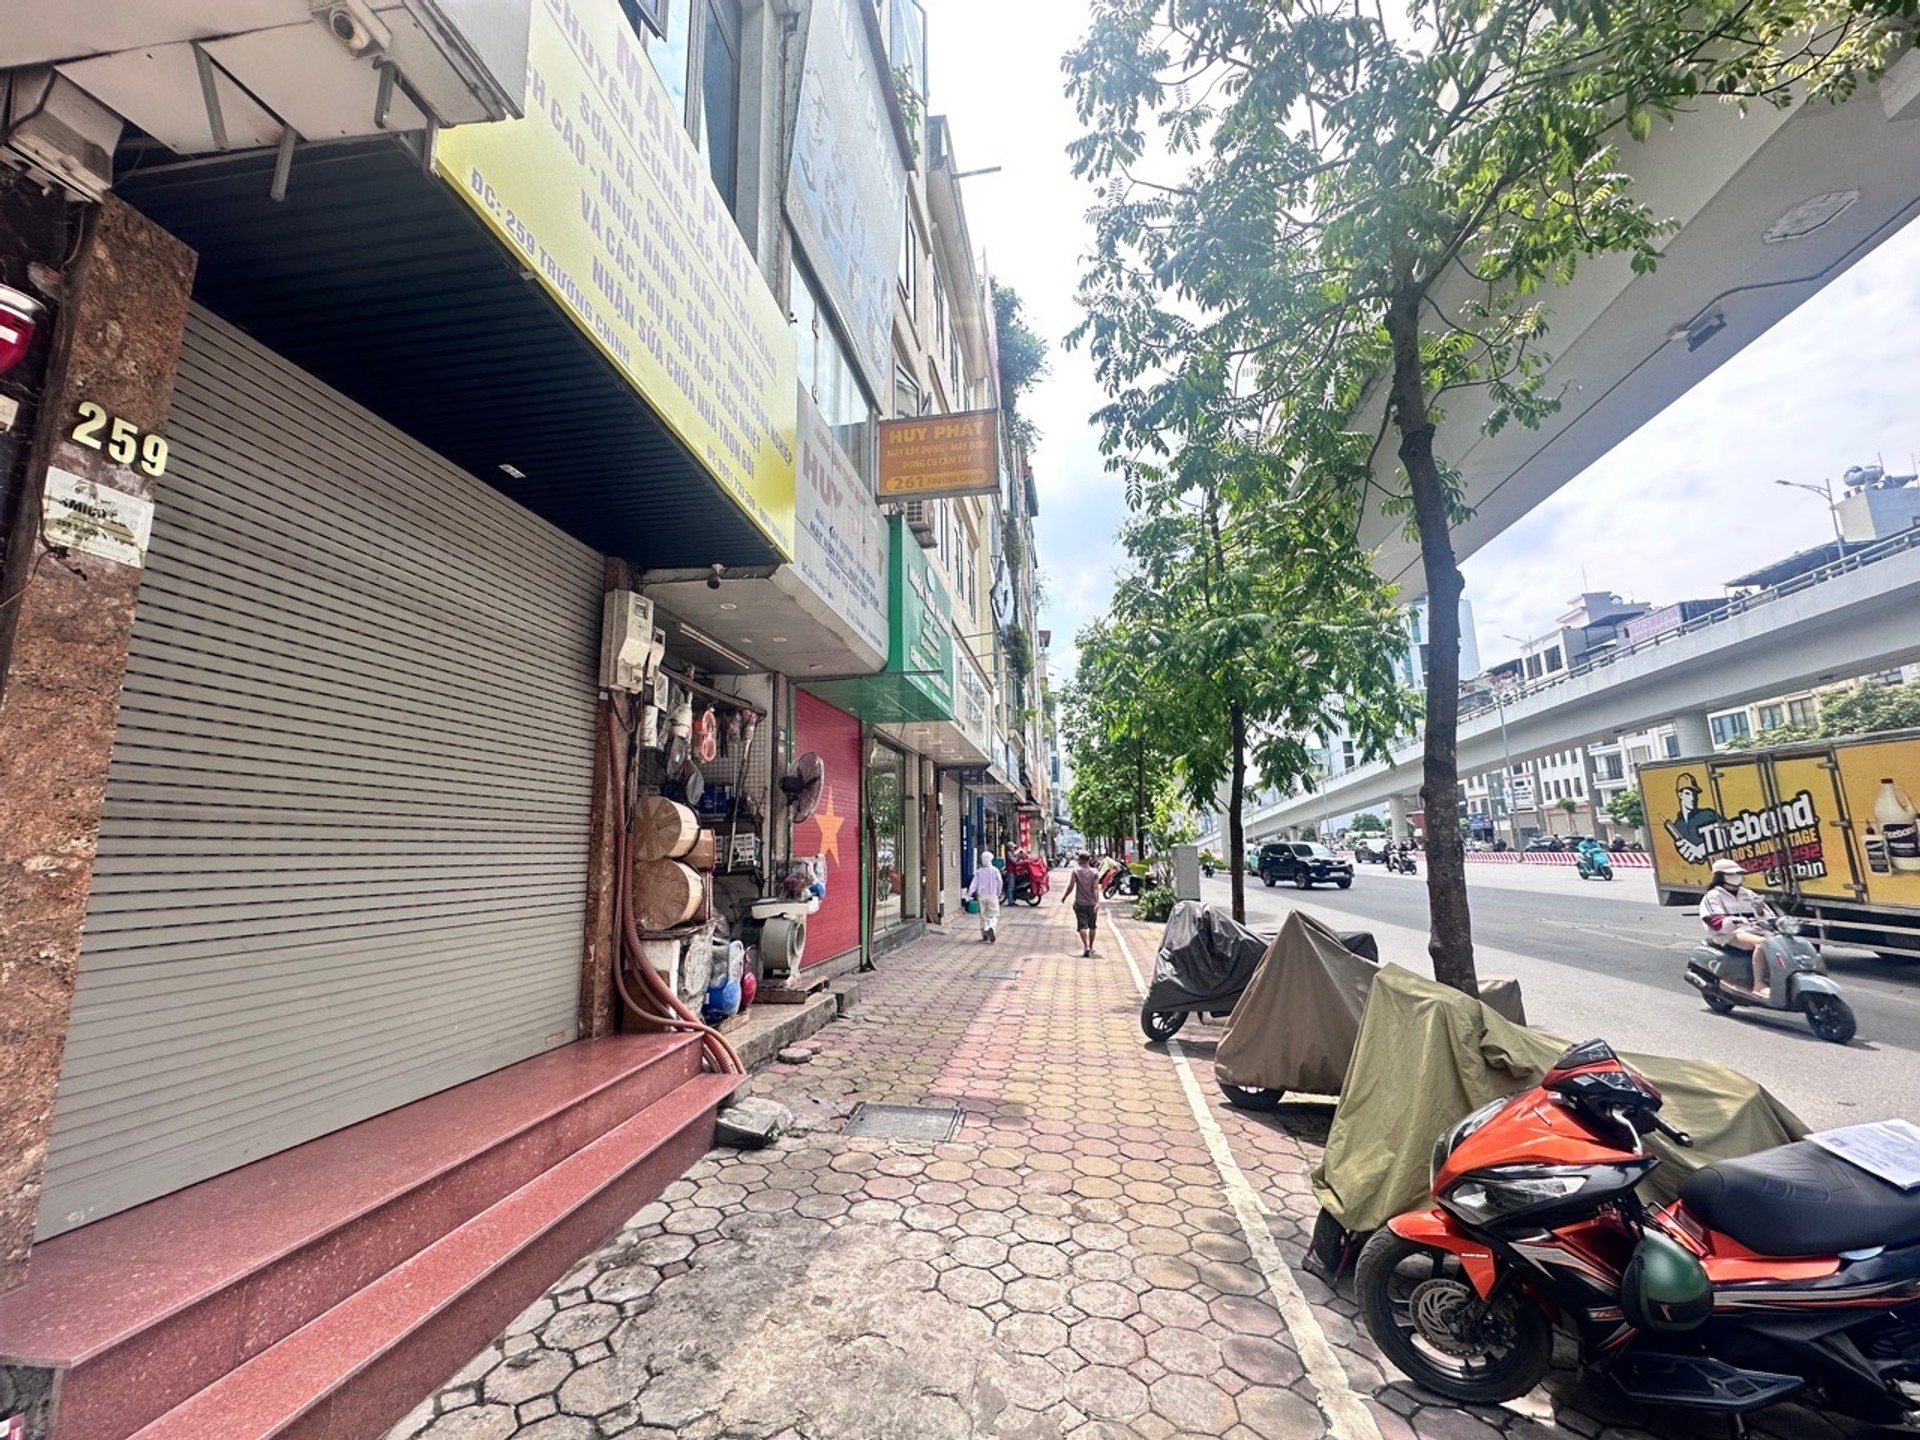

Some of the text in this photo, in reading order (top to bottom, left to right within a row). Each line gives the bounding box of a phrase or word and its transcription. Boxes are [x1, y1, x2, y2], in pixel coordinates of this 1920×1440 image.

[550, 97, 586, 167] CAO
[600, 170, 641, 248] NHỰA
[643, 234, 677, 300] NANO
[579, 90, 613, 162] SƠN
[646, 197, 686, 275] CHỐNG
[688, 262, 715, 321] THẤM
[616, 25, 751, 297] MẠNH PHÁT
[638, 127, 682, 221] CUNG
[686, 210, 713, 264] CẤP
[716, 262, 731, 299] VÀ
[733, 290, 750, 331] THI
[471, 168, 630, 365] ĐC: 259 TRƯỜNG CHINH
[580, 187, 602, 236] VÀ
[605, 224, 635, 282] CÁC
[637, 272, 663, 326] PHỤ
[666, 310, 692, 361] KIỆN
[715, 377, 737, 421] CÁCH
[592, 254, 635, 329] NHẬN
[638, 313, 664, 365] SỬA
[666, 350, 695, 403] CHỮA
[697, 390, 716, 431] NHÀ
[718, 418, 740, 461] TRỌN
[71, 401, 168, 477] 259
[802, 440, 843, 507] HUY
[887, 447, 904, 457] MÁY
[921, 443, 945, 455] DỰNG
[889, 419, 984, 443] HUY PHÁT
[894, 476, 924, 491] 261
[957, 454, 972, 464] TAY
[1727, 844, 1755, 861] RO'S
[1755, 828, 1818, 856] ADVTAGE
